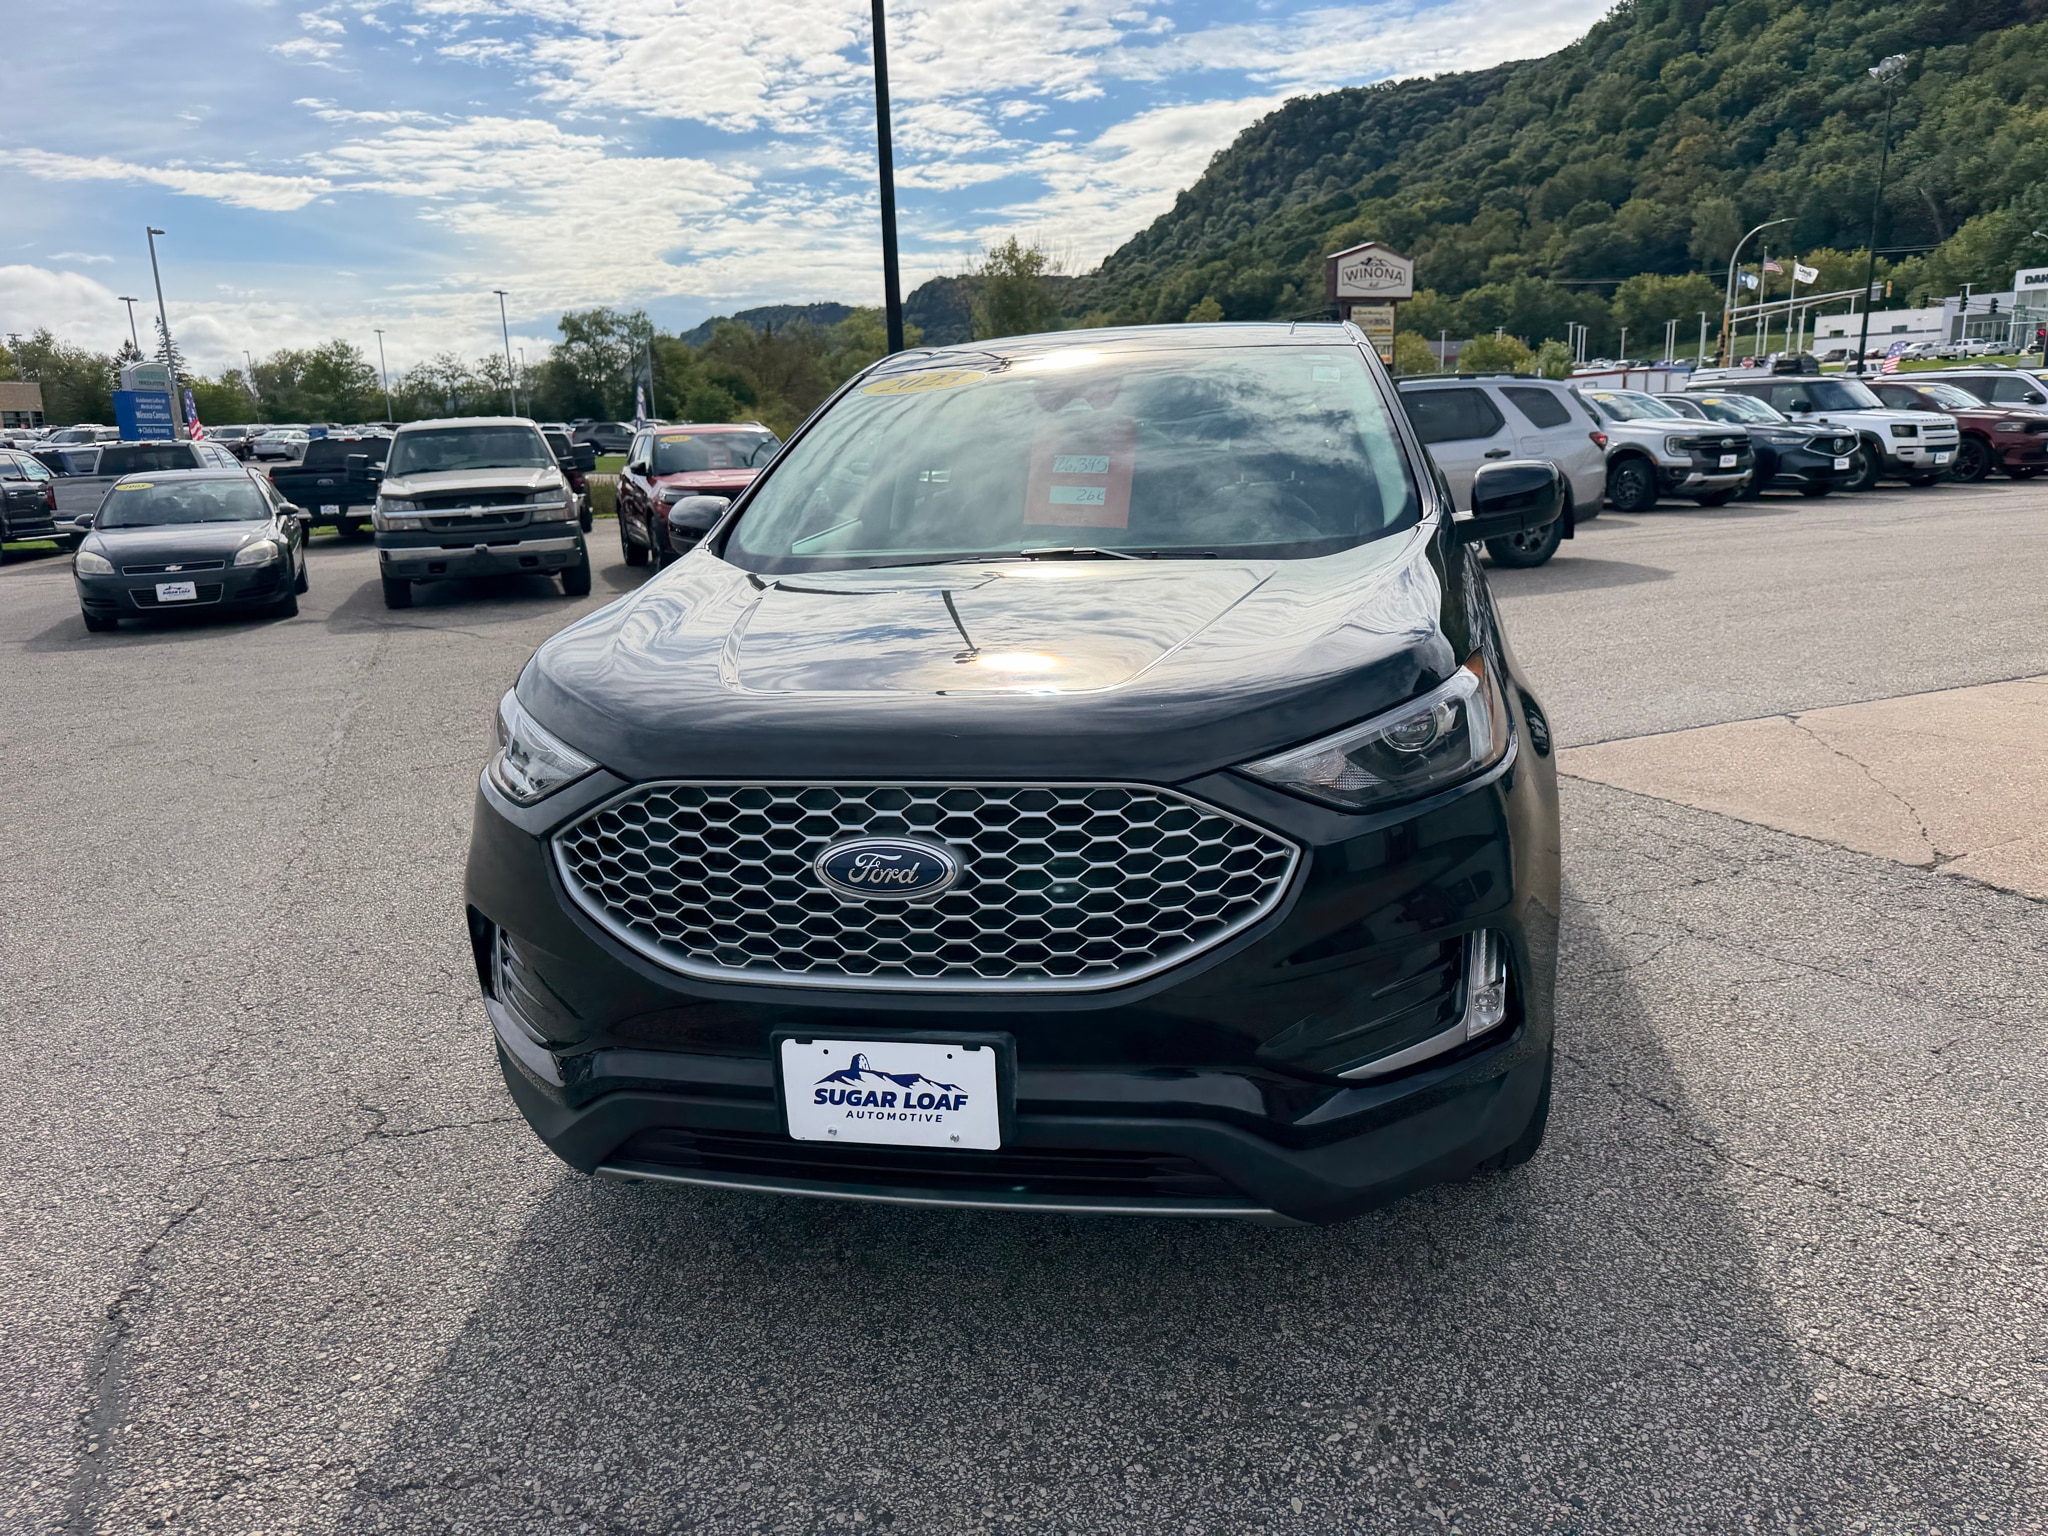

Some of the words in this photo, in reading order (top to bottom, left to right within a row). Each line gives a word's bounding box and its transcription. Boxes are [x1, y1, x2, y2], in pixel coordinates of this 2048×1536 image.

[1345, 267, 1403, 284] WINONA
[848, 852, 920, 884] Ford
[813, 1088, 898, 1109] SUGAR
[903, 1092, 969, 1111] LOAF
[845, 1110, 943, 1123] AUTOMOTIVE
